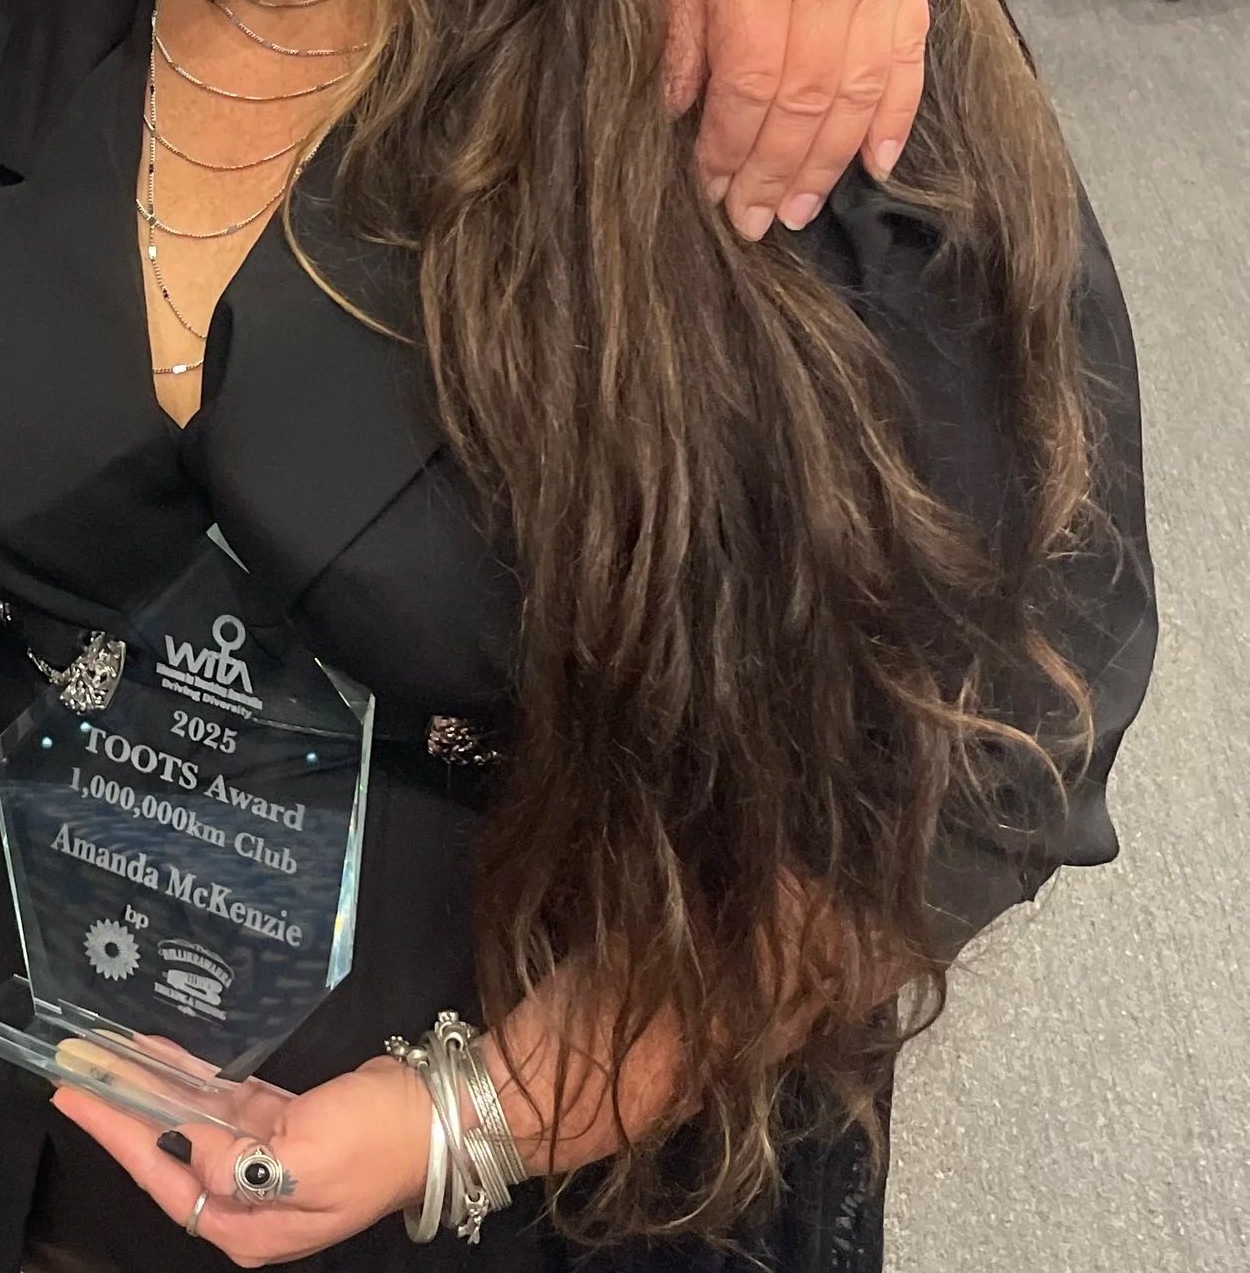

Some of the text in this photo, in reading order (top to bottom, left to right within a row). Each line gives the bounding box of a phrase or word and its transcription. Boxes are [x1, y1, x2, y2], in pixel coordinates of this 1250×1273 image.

[85, 727, 306, 831] TOOTS Award
[171, 710, 238, 754] 2025
[70, 767, 298, 874] 1,000,000km Club
[50, 822, 303, 947] Amanda McKenzie
[124, 904, 150, 929] bp
